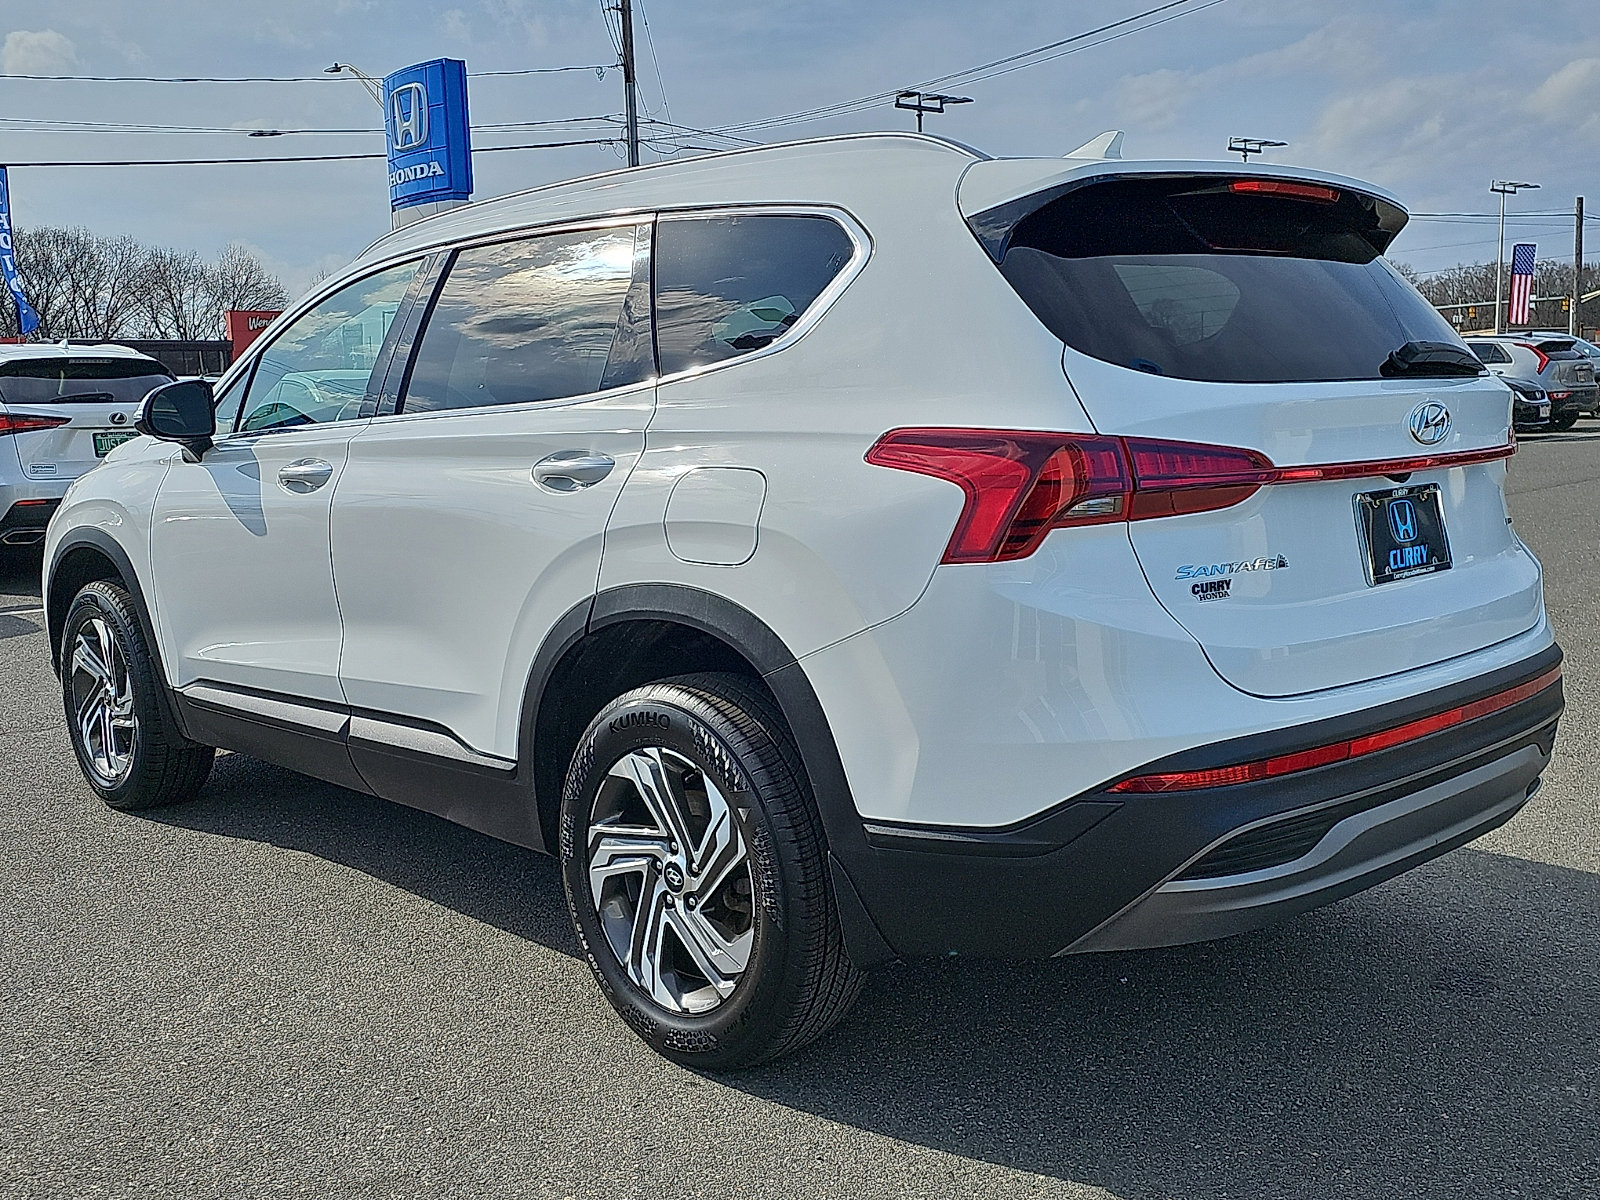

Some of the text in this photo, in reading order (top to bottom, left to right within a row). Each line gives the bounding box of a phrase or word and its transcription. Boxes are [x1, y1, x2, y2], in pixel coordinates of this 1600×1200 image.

[389, 161, 445, 187] HONDA
[1389, 543, 1428, 570] CURRY
[1191, 579, 1232, 595] CURRY
[1199, 591, 1231, 601] HONDA
[609, 711, 671, 735] KUMHO
